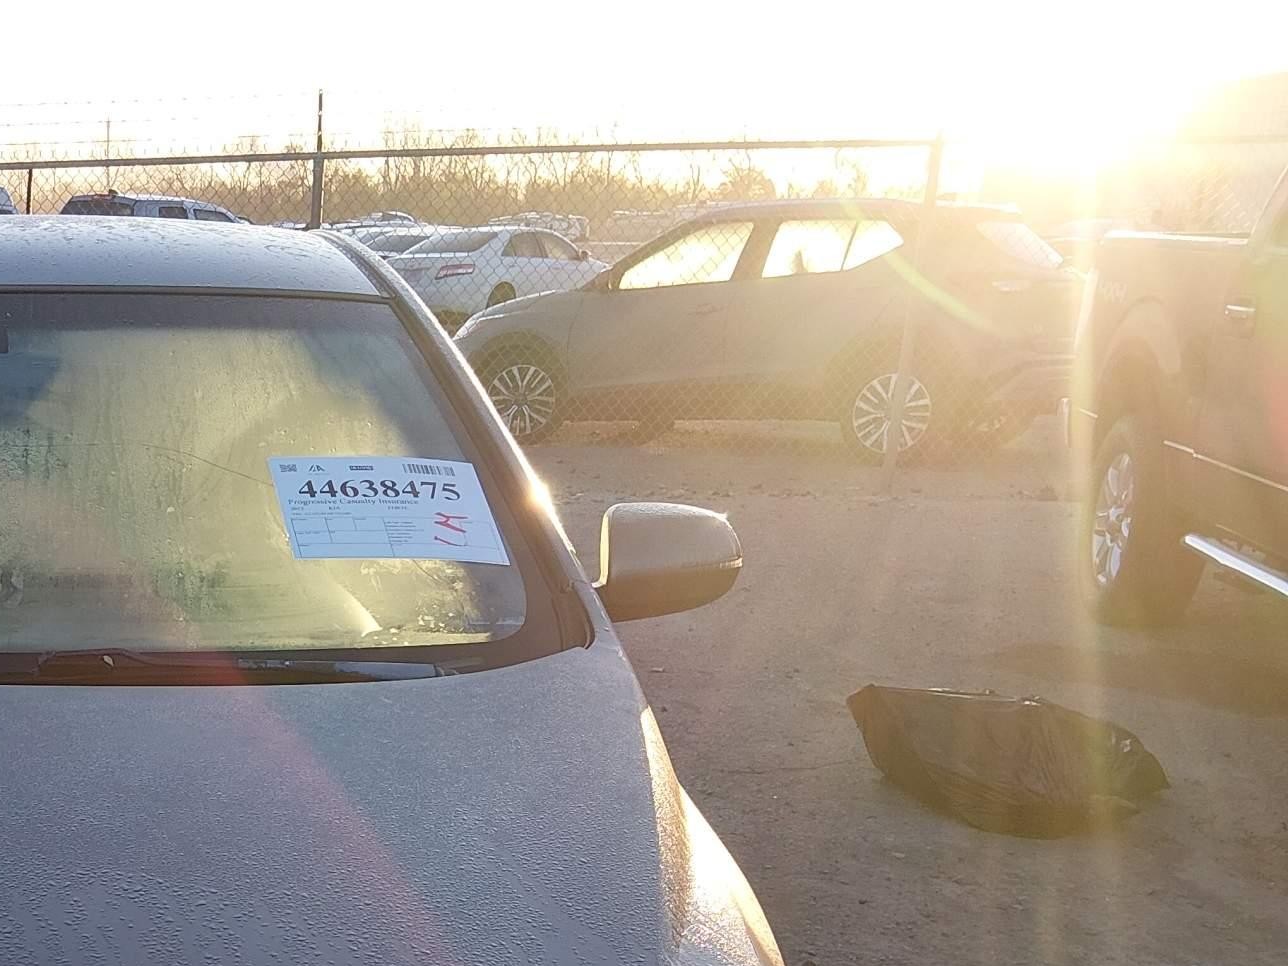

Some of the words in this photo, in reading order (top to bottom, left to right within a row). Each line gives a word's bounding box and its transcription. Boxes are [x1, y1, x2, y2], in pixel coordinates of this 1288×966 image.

[298, 479, 460, 501] 44638475
[288, 498, 337, 506] Progressive
[339, 498, 375, 506] Casualty
